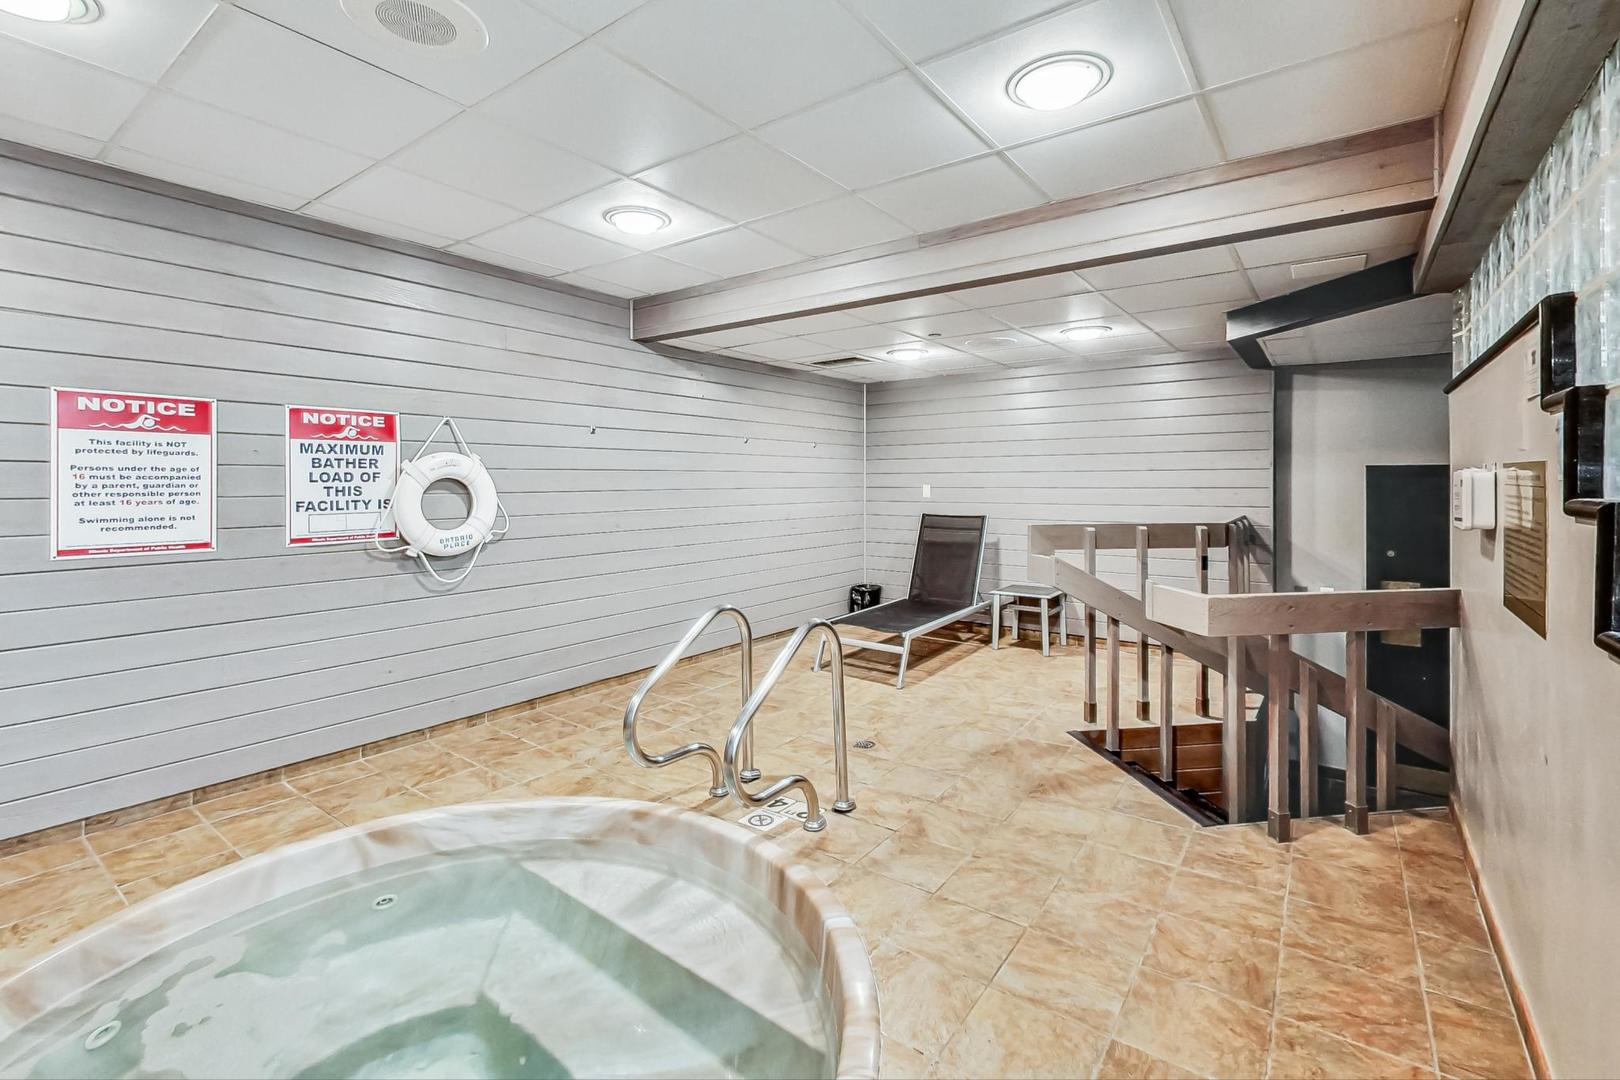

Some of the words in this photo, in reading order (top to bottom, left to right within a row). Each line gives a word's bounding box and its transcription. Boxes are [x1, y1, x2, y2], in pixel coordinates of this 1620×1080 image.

[77, 396, 196, 416] NOTICE
[302, 412, 385, 427] NOTICE
[88, 438, 112, 446] This
[115, 439, 151, 448] facility
[146, 449, 200, 457] lifeguards.
[299, 442, 384, 456] MAXIMUM
[70, 464, 114, 472] Persons
[311, 457, 379, 469] BATHER
[308, 472, 354, 483] LOAD
[360, 471, 381, 482] OF
[142, 482, 186, 490] guardian
[323, 485, 363, 497] THIS
[135, 499, 163, 507] years
[295, 499, 372, 512] FACILITY
[377, 498, 392, 510] IS
[78, 516, 135, 524] Swimming
[100, 523, 177, 532] recommended.
[443, 540, 470, 550] PLACE
